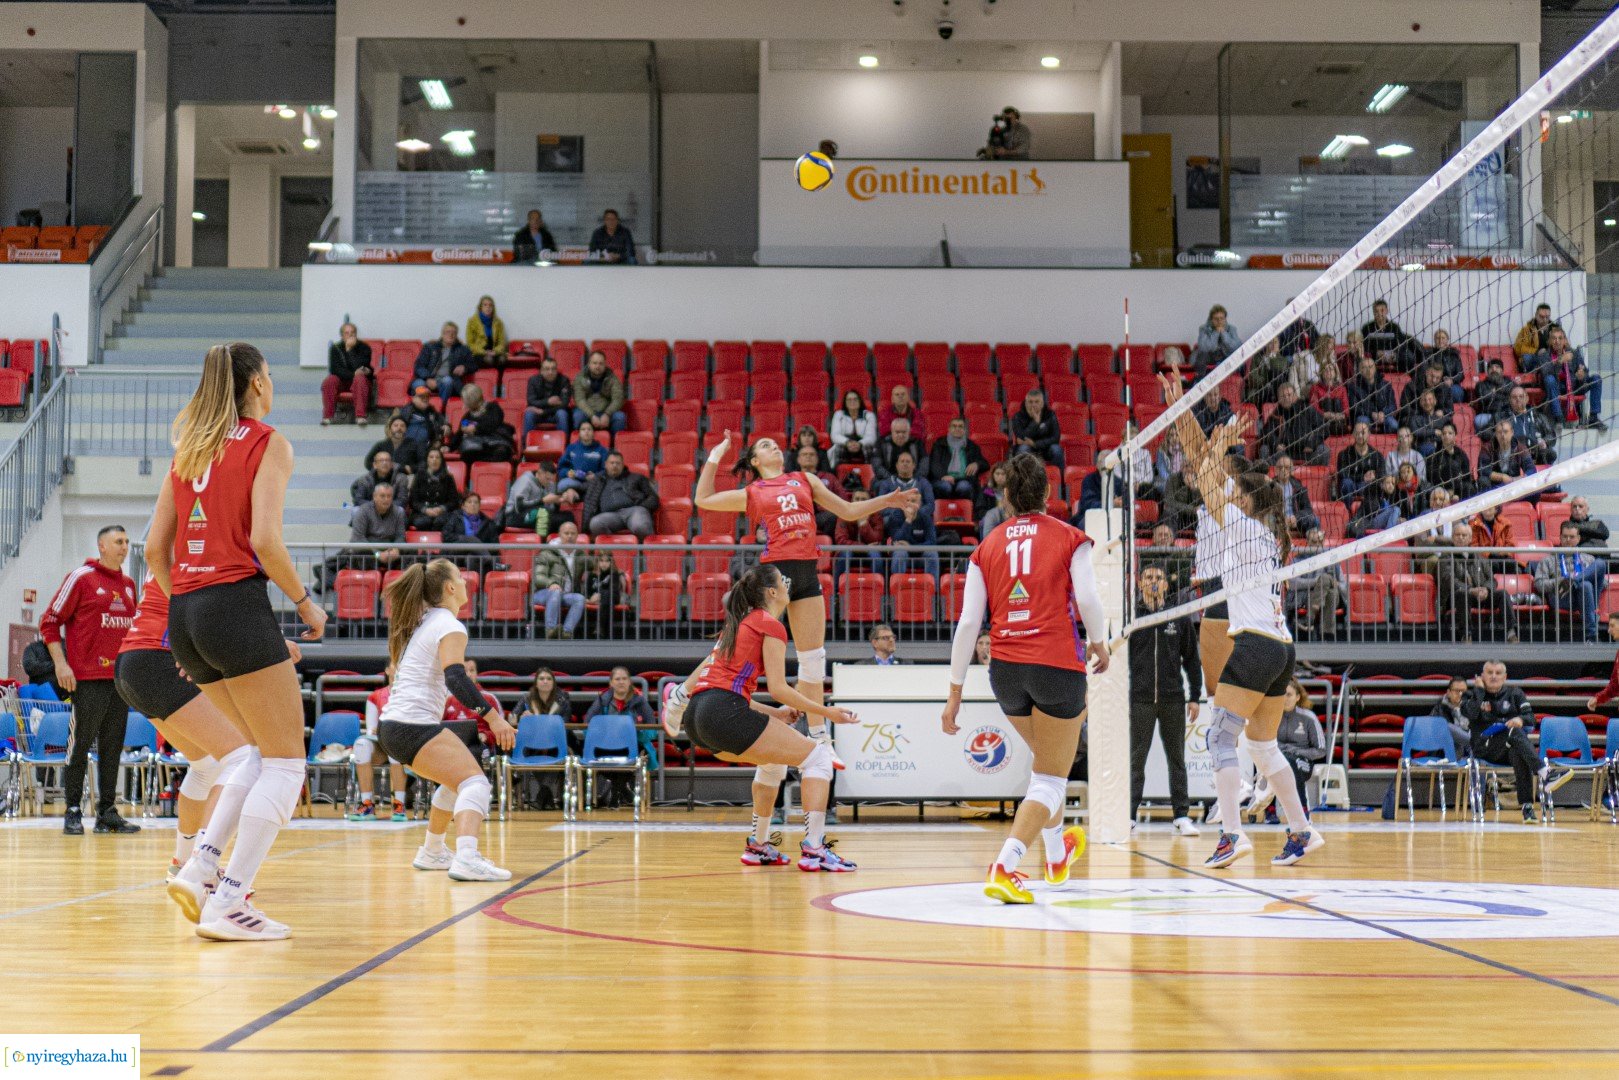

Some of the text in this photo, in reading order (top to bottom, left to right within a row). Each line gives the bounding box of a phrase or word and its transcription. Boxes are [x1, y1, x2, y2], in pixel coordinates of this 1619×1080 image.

[846, 165, 1018, 200] Continental
[432, 248, 493, 263] Continental
[539, 248, 600, 262] Continental
[777, 494, 799, 512] 23
[1006, 524, 1038, 539] ÇEPNI
[1005, 538, 1032, 577] 11
